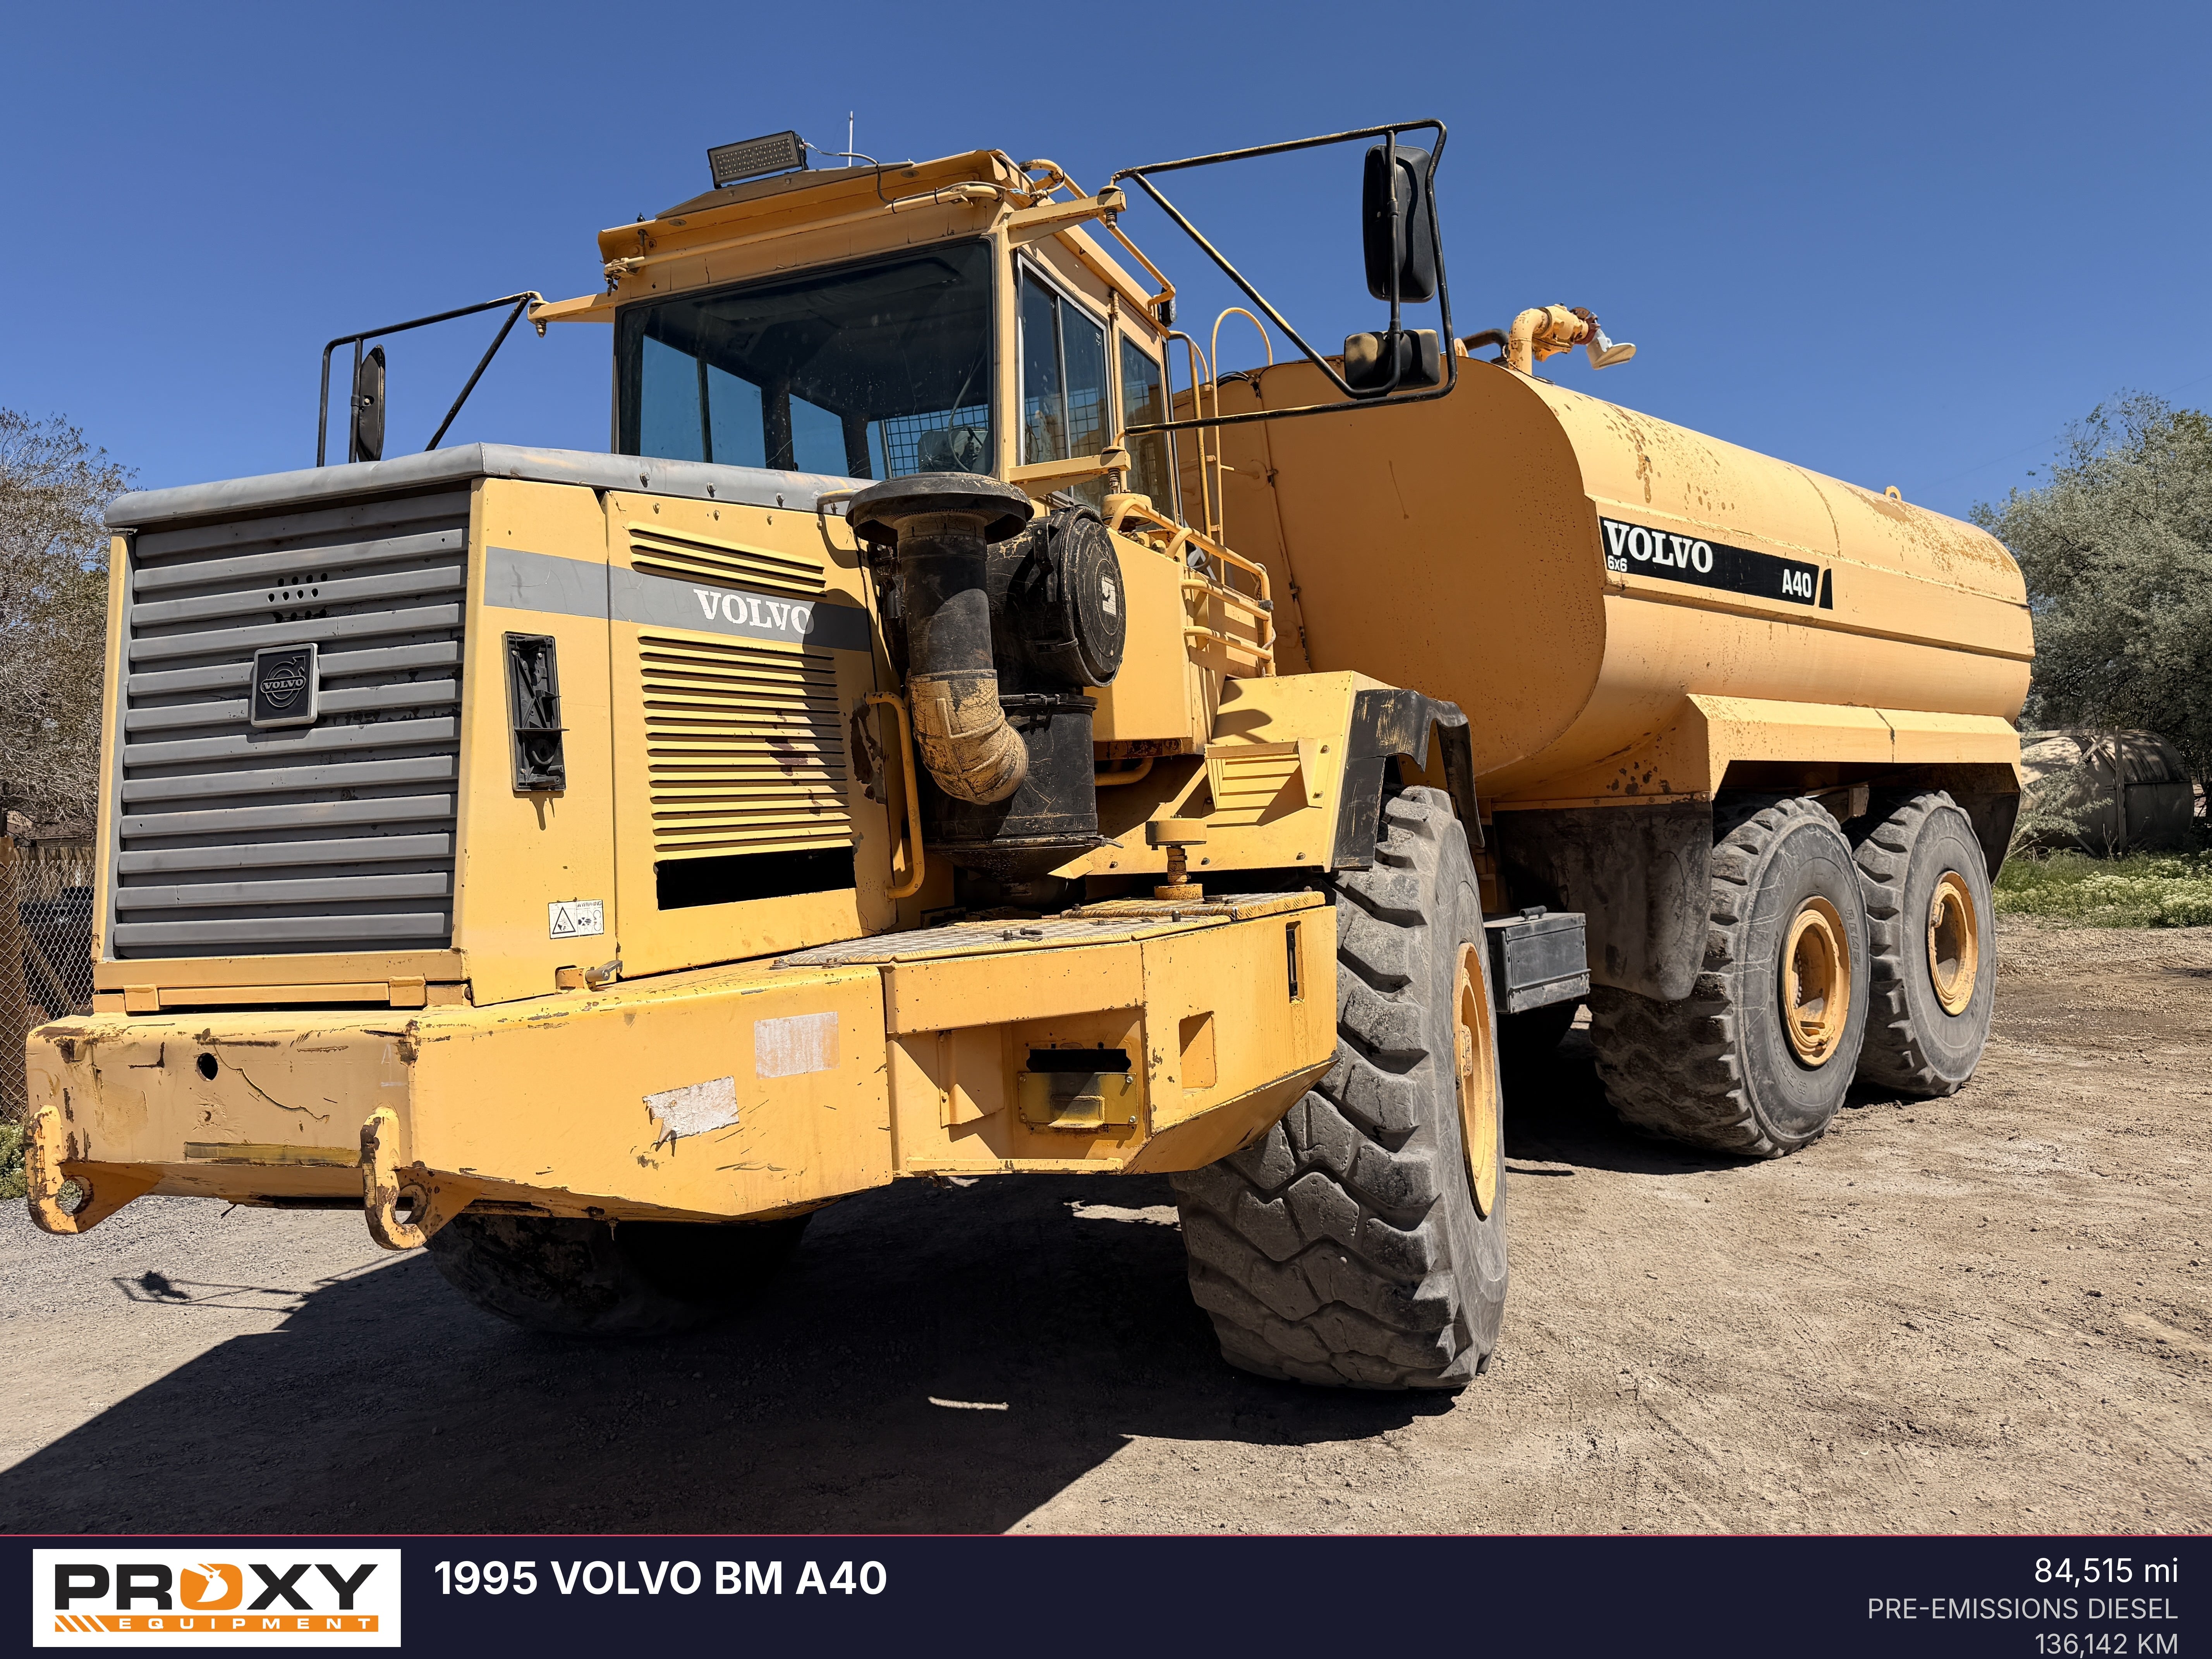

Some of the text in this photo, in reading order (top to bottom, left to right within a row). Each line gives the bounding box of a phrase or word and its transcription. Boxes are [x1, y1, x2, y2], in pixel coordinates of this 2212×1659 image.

[1604, 520, 1812, 598] VOLVO A40
[693, 589, 814, 634] VOLVO
[263, 679, 304, 689] VOLVO
